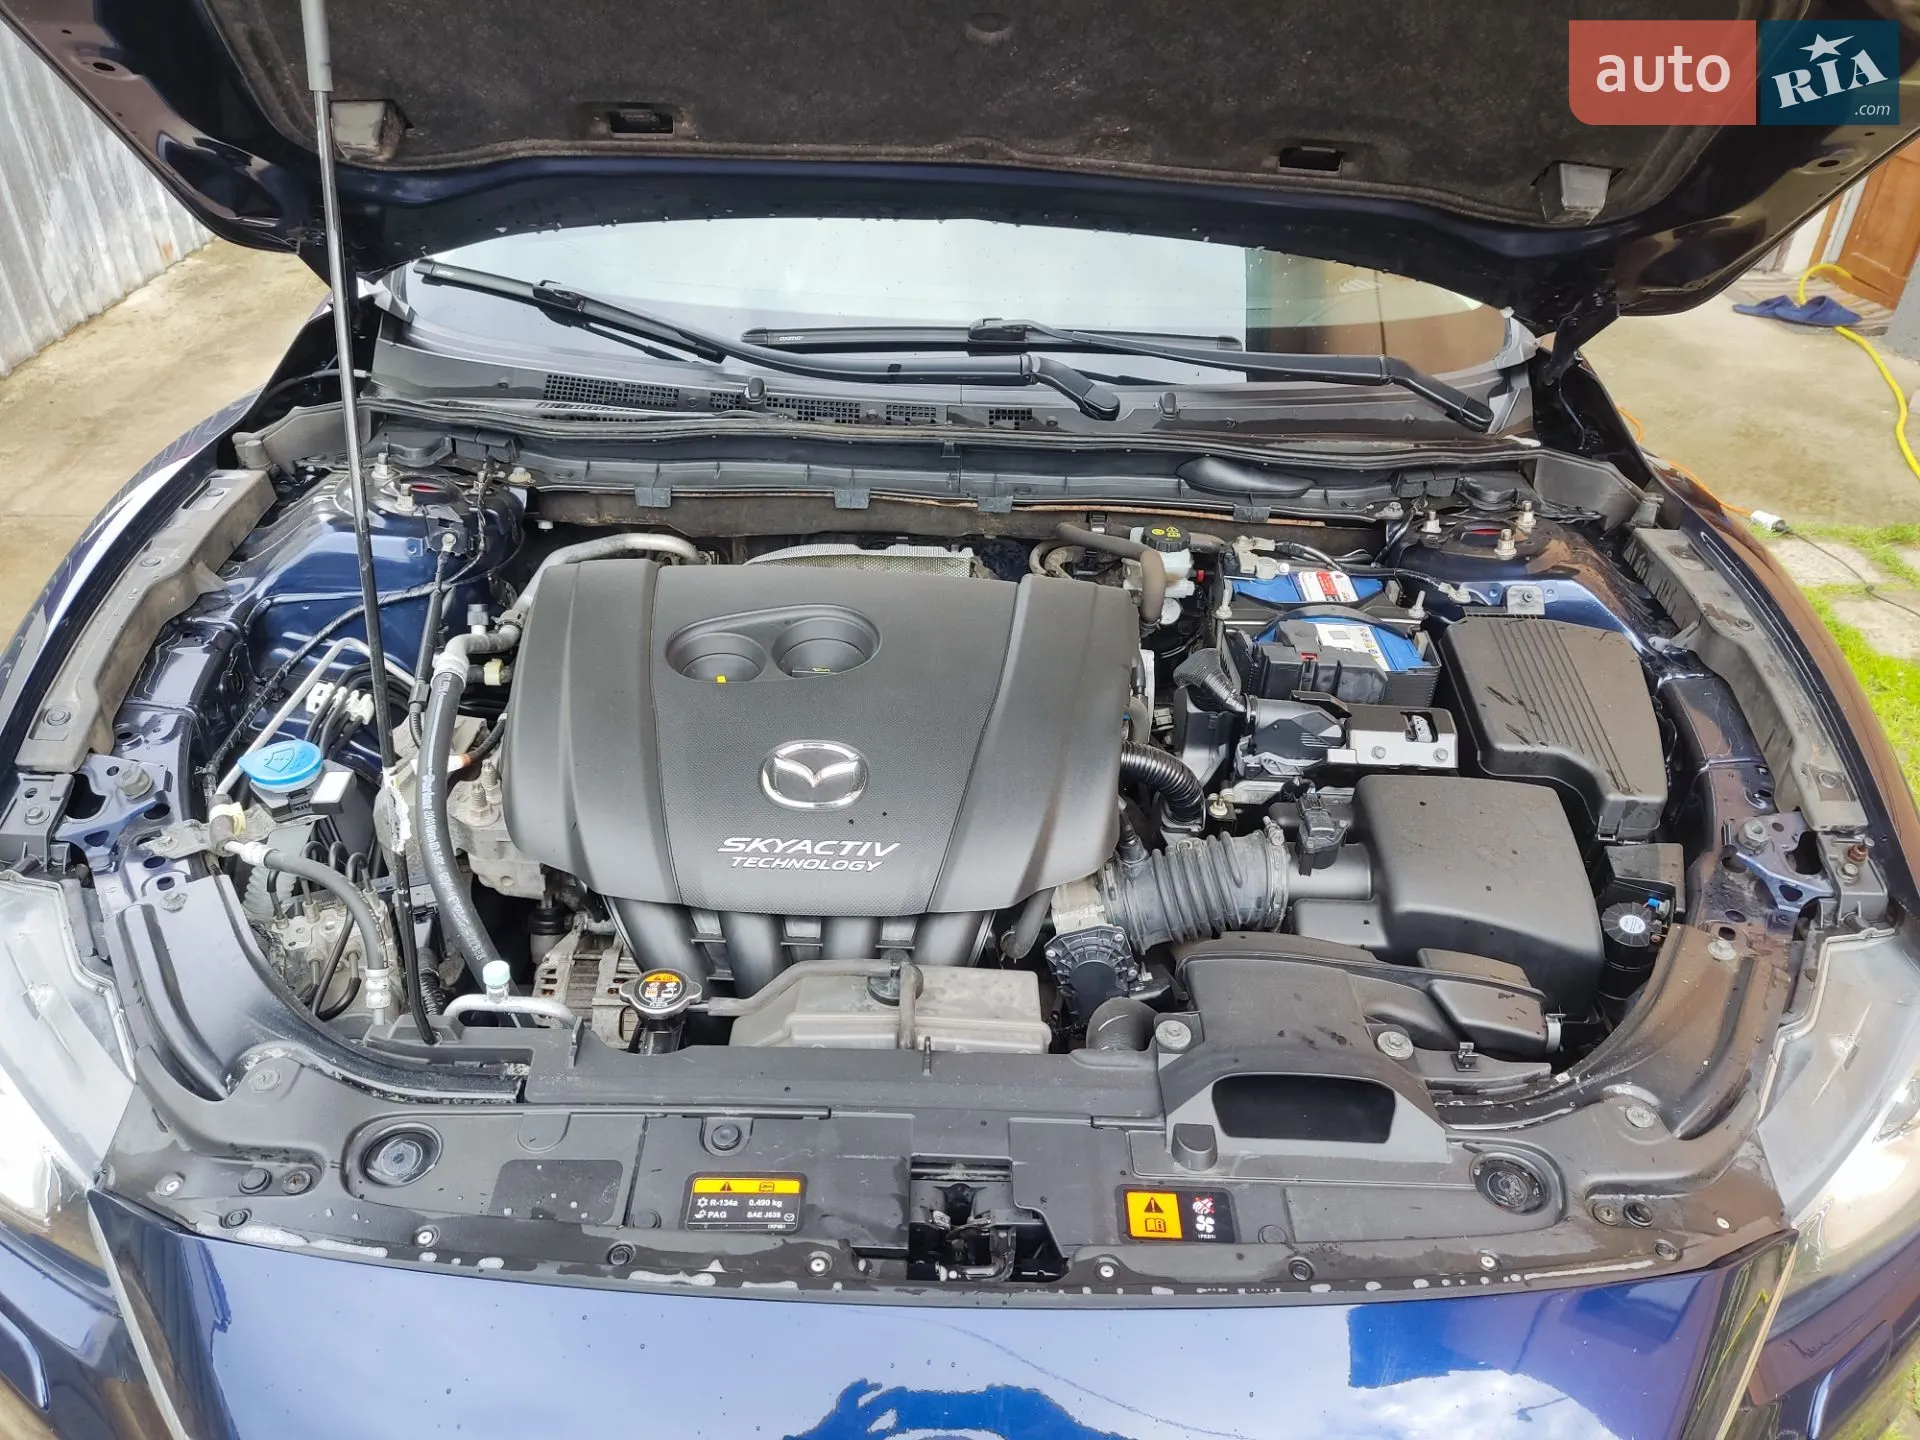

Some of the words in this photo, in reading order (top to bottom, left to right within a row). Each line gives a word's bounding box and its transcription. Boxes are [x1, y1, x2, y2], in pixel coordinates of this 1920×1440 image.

[717, 837, 900, 857] SKYACTIV
[731, 856, 882, 872] TECHNOLOGY
[710, 1199, 739, 1207] R-134a
[771, 1199, 783, 1208] kg
[707, 1211, 727, 1219] PAG
